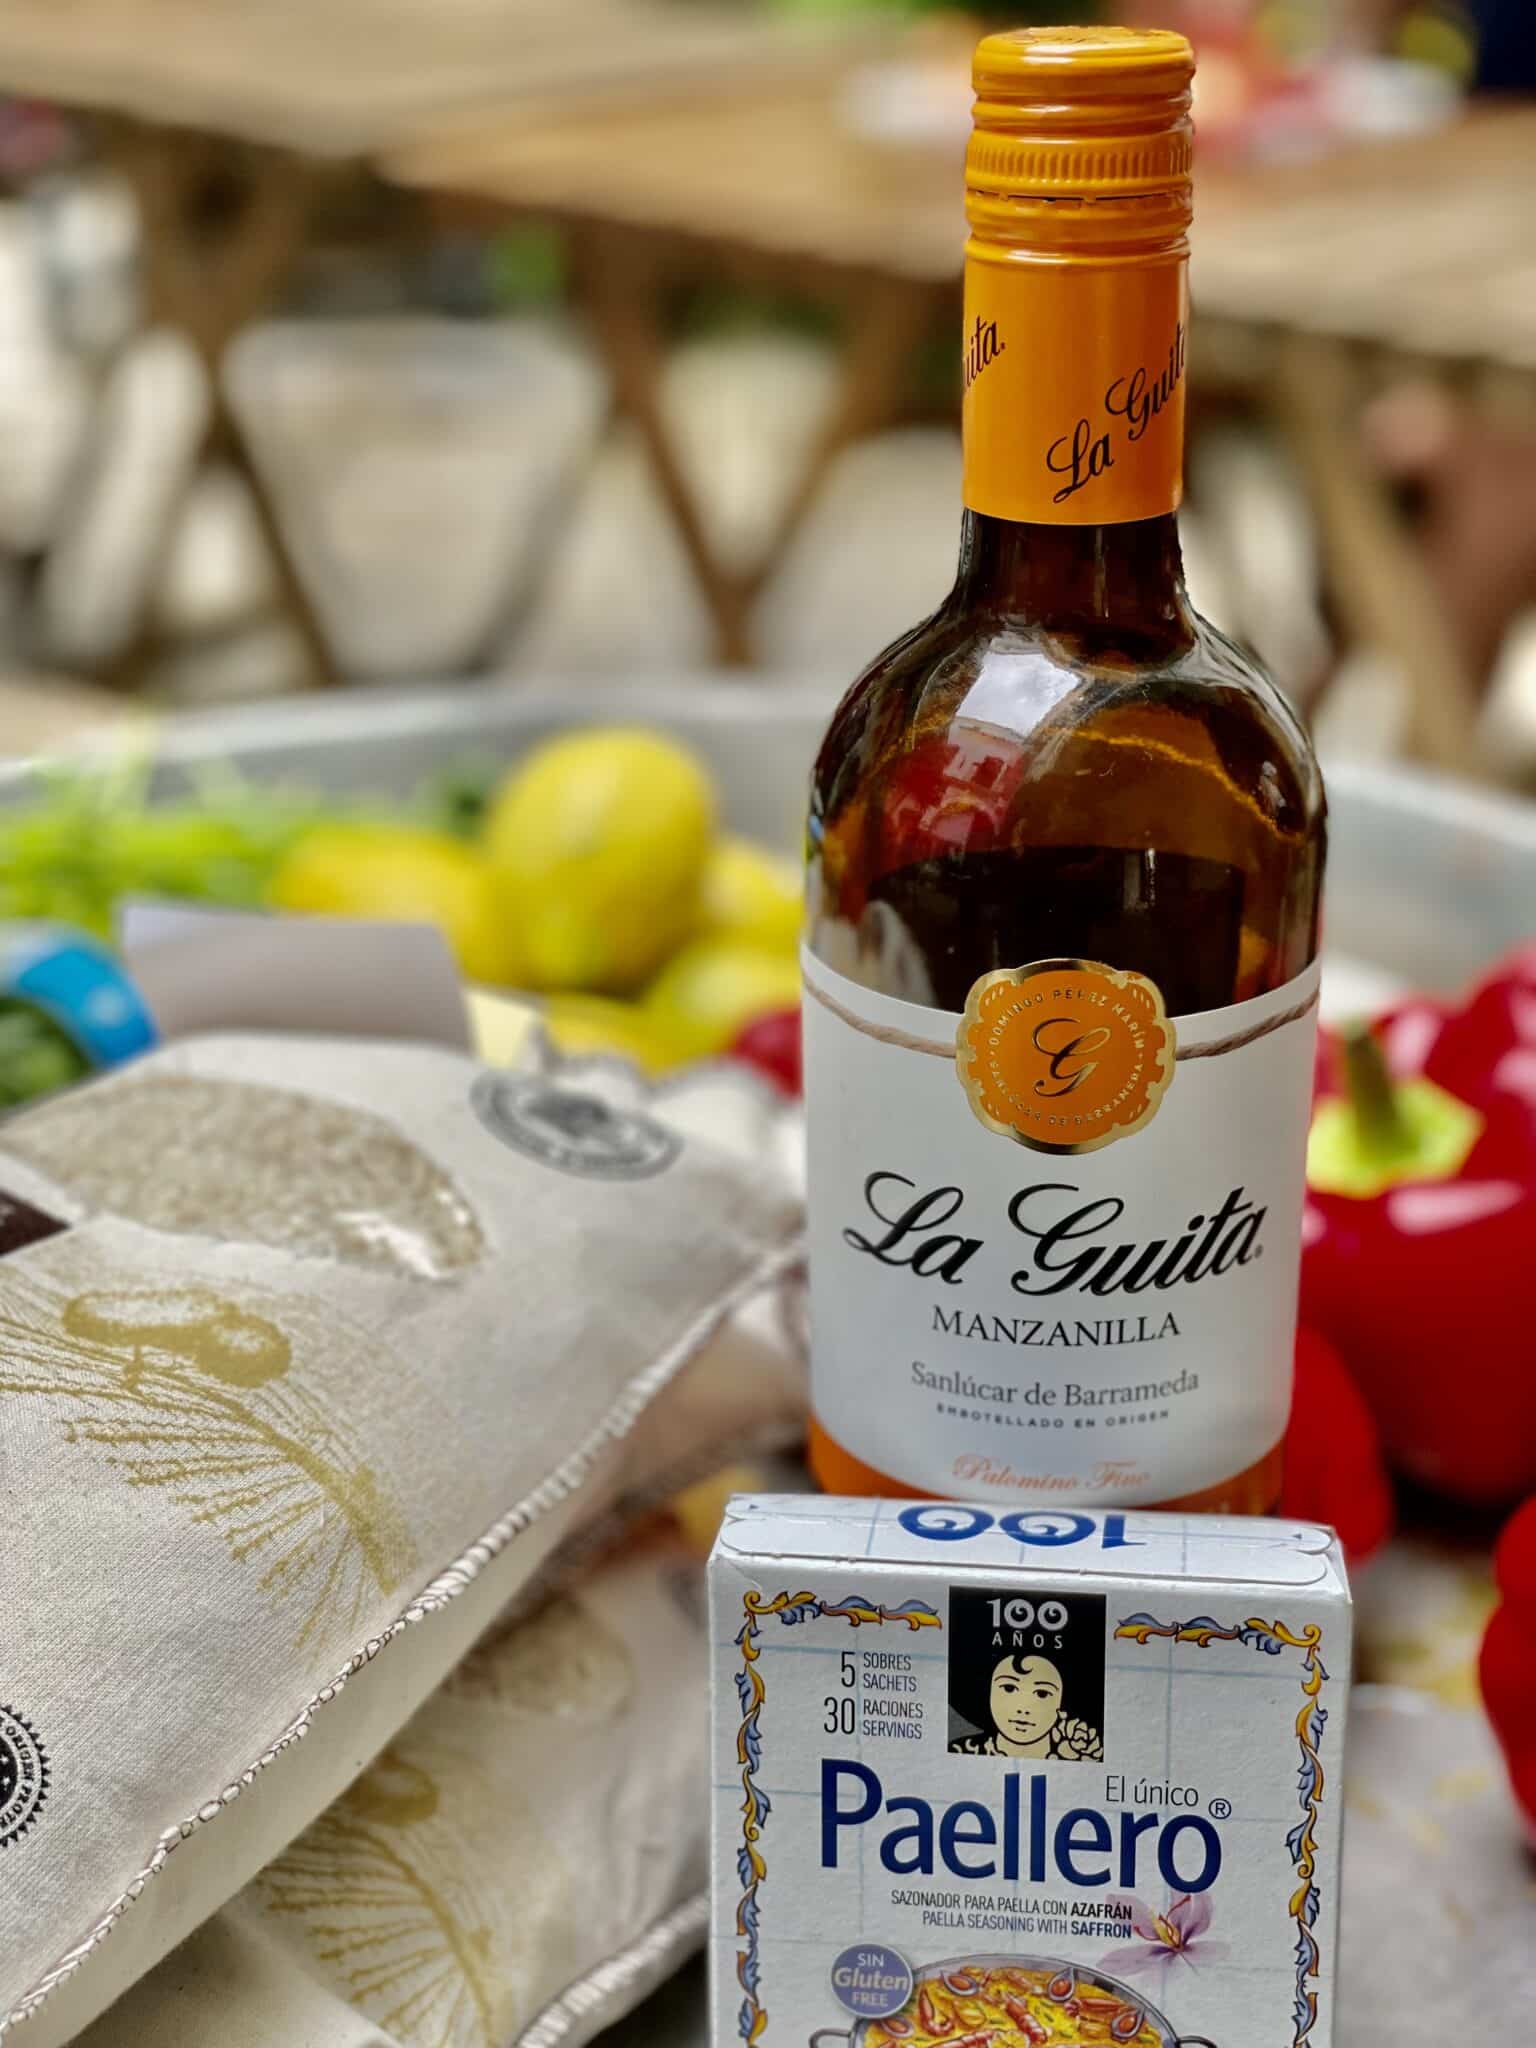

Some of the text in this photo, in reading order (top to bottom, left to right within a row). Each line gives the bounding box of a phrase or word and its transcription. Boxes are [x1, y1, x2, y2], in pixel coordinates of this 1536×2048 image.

[1046, 418, 1114, 504] La
[1031, 1017, 1112, 1098] G
[842, 1171, 1268, 1297] La Guita
[931, 1304, 1181, 1347] MANZANILLA
[911, 1361, 1200, 1407] Sanlúcar de Barrameda
[936, 1402, 1170, 1429] EMBOTELLADO EN ORIGEN
[952, 1453, 1151, 1493] Palomino Fino
[985, 1598, 1069, 1632] 100
[991, 1630, 1064, 1650] AÑOS
[840, 1651, 856, 1688] 5
[863, 1651, 912, 1672] SOBRES
[863, 1673, 918, 1693] SACHETS
[823, 1696, 856, 1735] 30
[863, 1698, 924, 1719] RACIONES
[862, 1719, 923, 1740] SERVINGS
[1105, 1775, 1199, 1808] El único
[820, 1757, 1222, 1894] Paellero
[891, 1889, 1133, 1920] SAZONADOR PARA PAELLA CON AZAFRÁN
[922, 1911, 1132, 1939] PAELLA SEASONING WITH SAFFRON
[857, 1952, 885, 1968] SIN
[834, 1967, 909, 1991] Gluten
[851, 1991, 889, 2008] FREE
